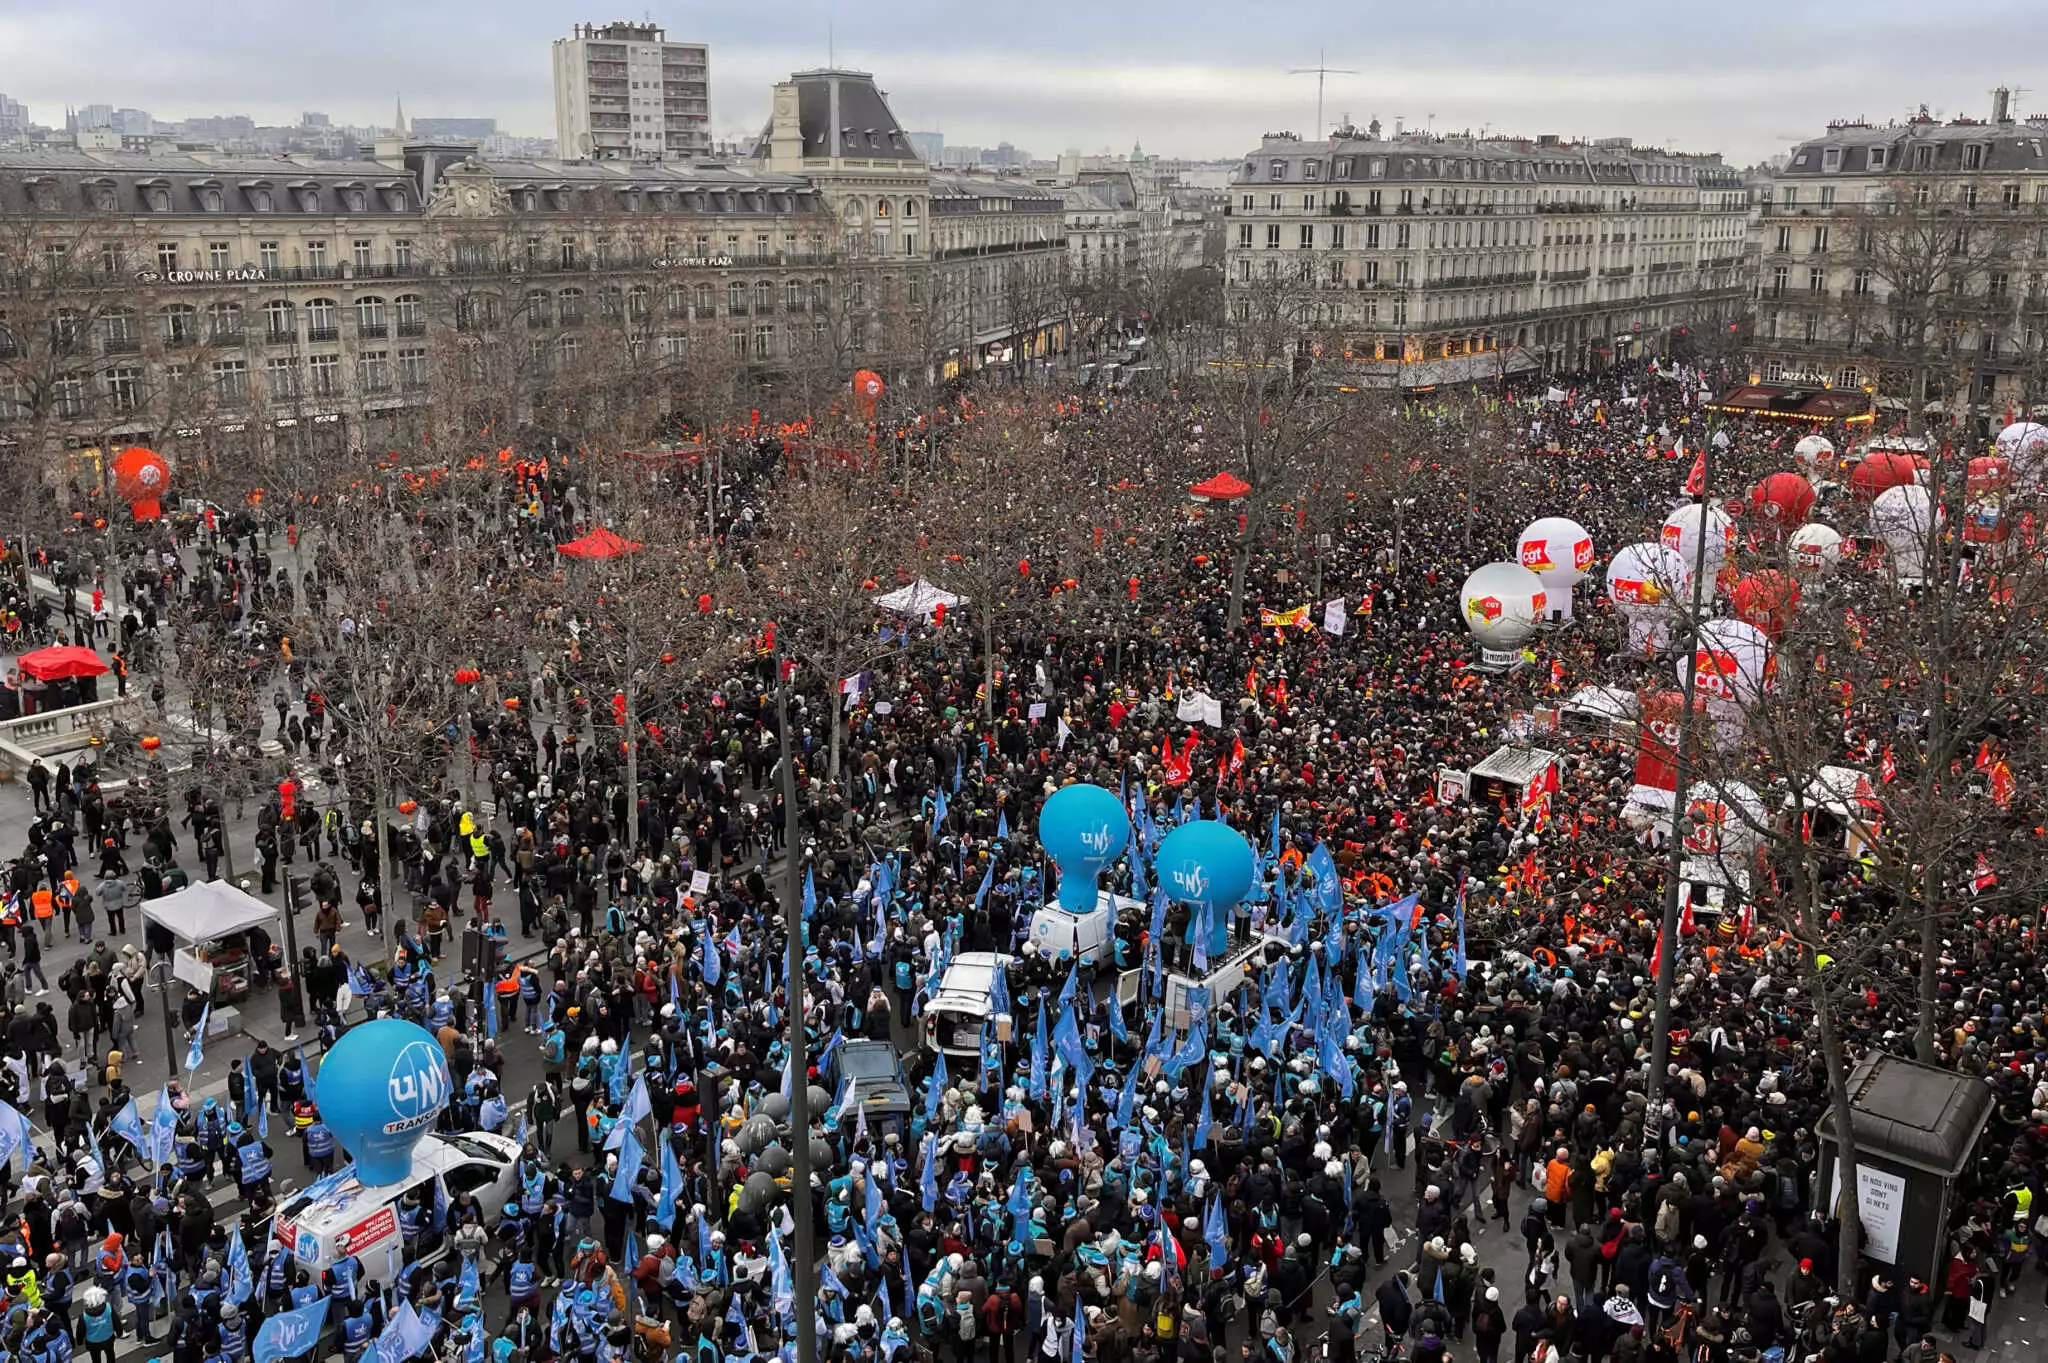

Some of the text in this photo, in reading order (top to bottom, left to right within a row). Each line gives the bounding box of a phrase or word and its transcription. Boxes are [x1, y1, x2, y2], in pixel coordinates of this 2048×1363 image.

[168, 269, 265, 282] CROWNE PLAZA
[1782, 371, 1807, 382] PIZZA
[1523, 548, 1542, 564] cgt
[1616, 587, 1638, 602] cgt
[386, 1108, 441, 1133] TRANSP
[1870, 1177, 1882, 1187] NOS
[1883, 1182, 1899, 1193] VINS
[1870, 1188, 1887, 1199] SONT
[1873, 1199, 1890, 1211] NETS
